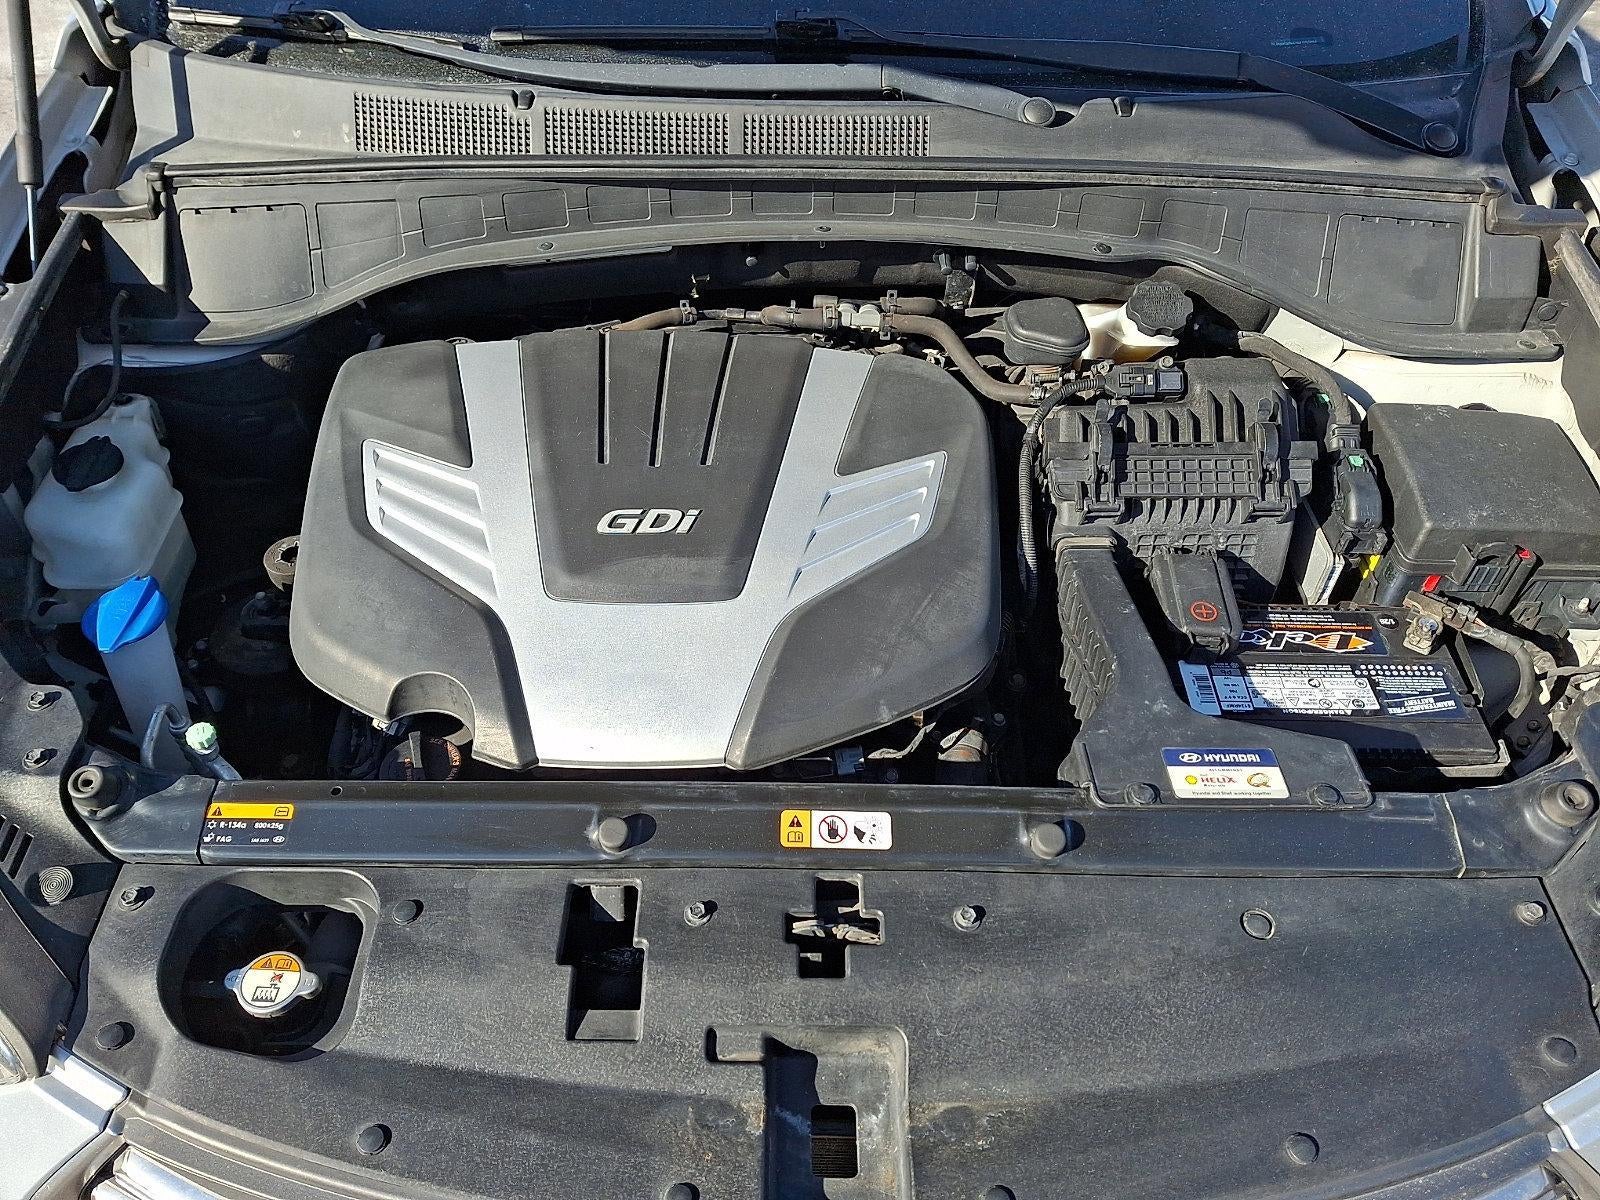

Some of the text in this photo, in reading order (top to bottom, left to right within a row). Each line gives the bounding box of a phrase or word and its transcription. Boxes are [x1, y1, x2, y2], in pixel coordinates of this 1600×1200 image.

[596, 508, 702, 534] GDi
[1404, 697, 1434, 707] BATTERY
[1387, 700, 1456, 715] MAINTENANCE-FREE
[1204, 753, 1261, 763] HYUNDAI
[1200, 776, 1237, 784] HELIX
[219, 821, 247, 829] R-134a
[215, 835, 232, 843] PAG
